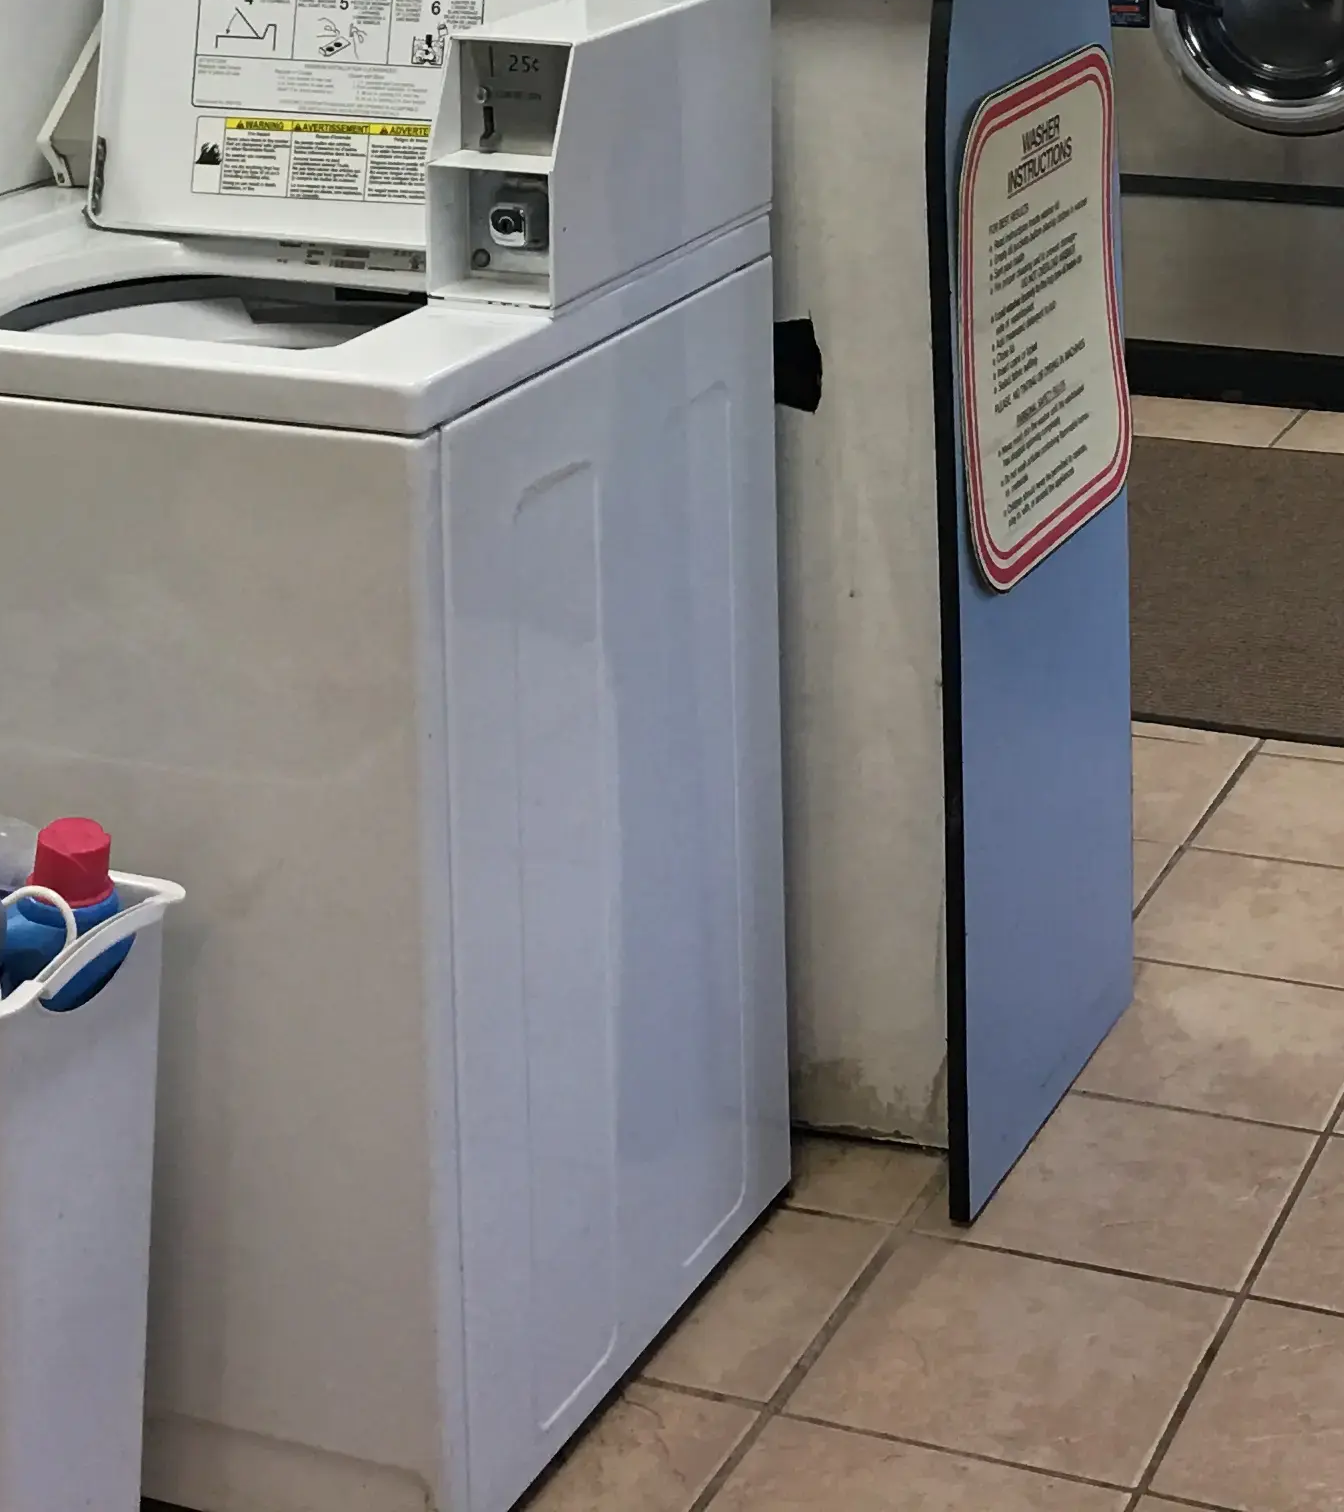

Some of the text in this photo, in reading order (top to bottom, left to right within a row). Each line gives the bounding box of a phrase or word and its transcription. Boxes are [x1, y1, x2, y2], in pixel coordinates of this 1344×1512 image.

[431, 1, 441, 15] 6
[509, 54, 539, 73] 25¢
[245, 121, 284, 130] WARNING
[302, 122, 369, 133] AVERTISSEMENT
[1022, 114, 1060, 154] WASHER
[1007, 136, 1072, 193] INSTRUCTIONS
